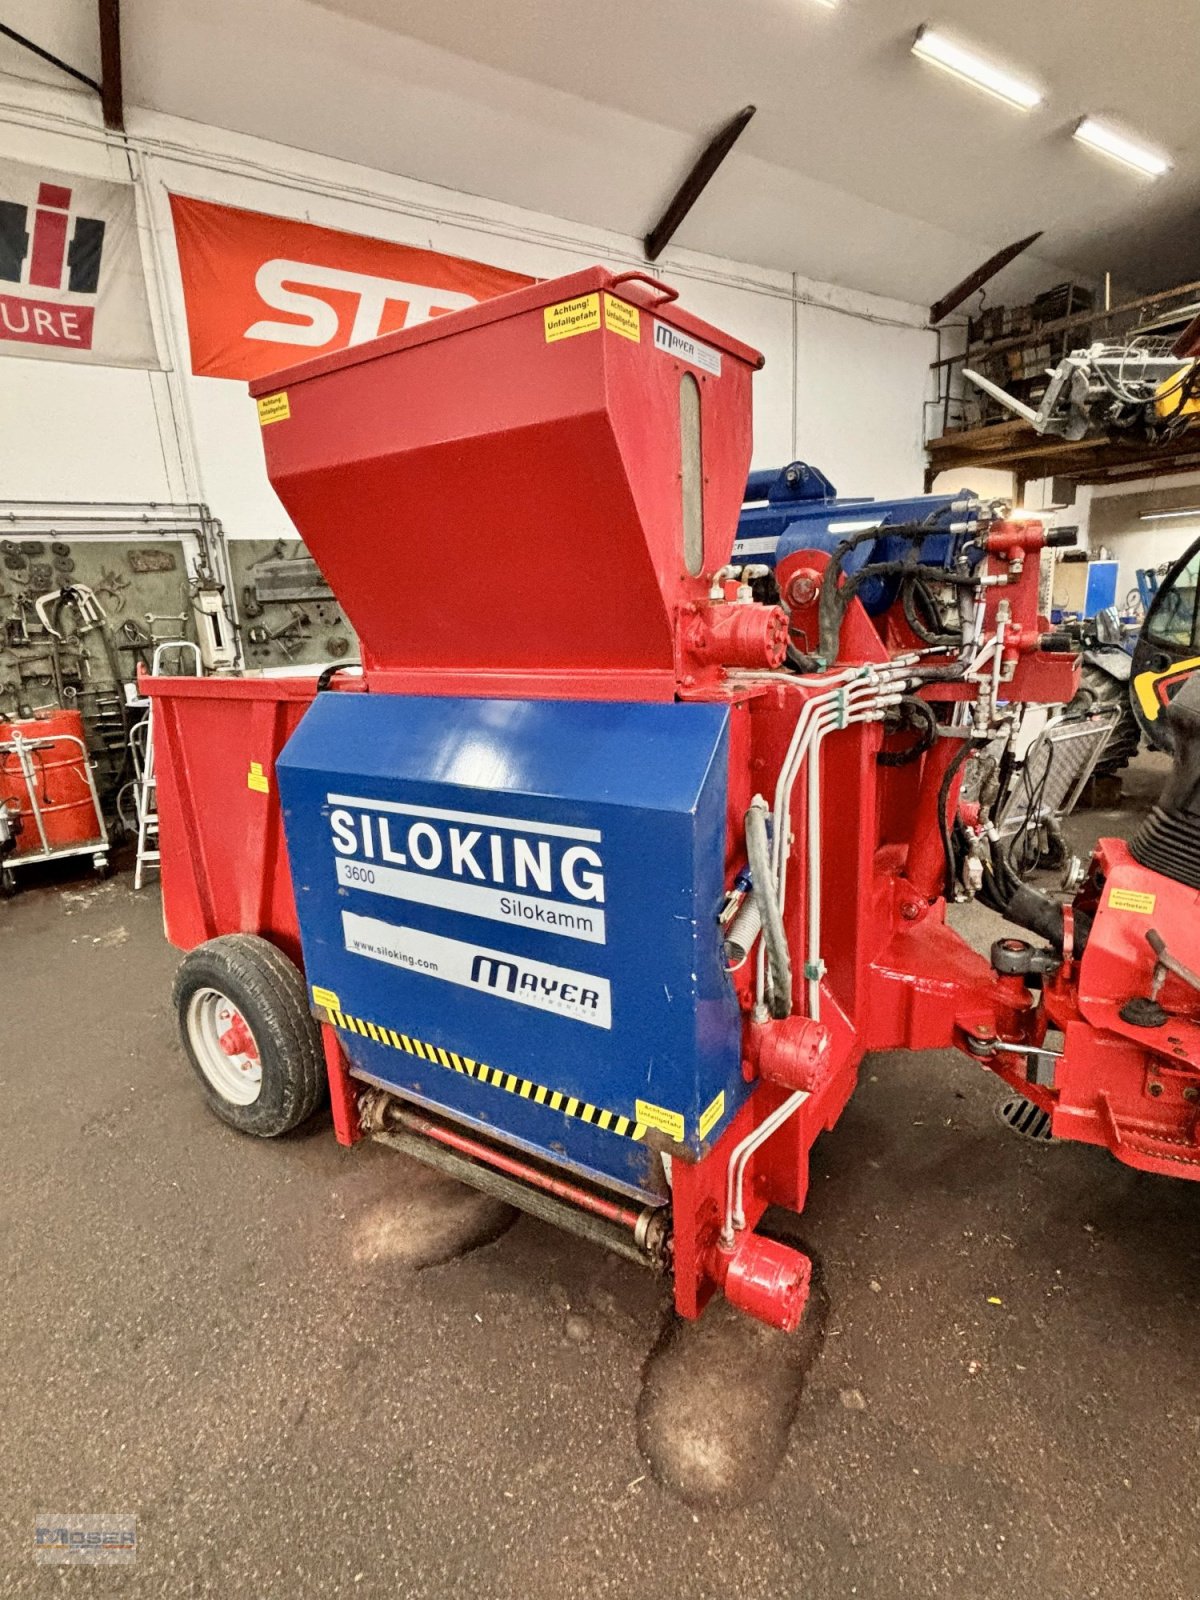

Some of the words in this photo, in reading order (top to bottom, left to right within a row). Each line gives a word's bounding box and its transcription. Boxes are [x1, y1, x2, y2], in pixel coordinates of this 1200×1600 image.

[553, 298, 590, 316] Achtung!
[610, 299, 634, 318] Achtung!
[547, 310, 598, 330] Unfallgefahr
[606, 308, 639, 331] Unfallgefahr
[656, 325, 695, 355] MAYER
[329, 809, 605, 903] SILOKING
[344, 864, 375, 885] 3600
[500, 897, 594, 932] Silokamm
[353, 940, 439, 972] www.siloking.com
[470, 955, 600, 1009] MAYER
[638, 1109, 682, 1130] Unfallgefahr
